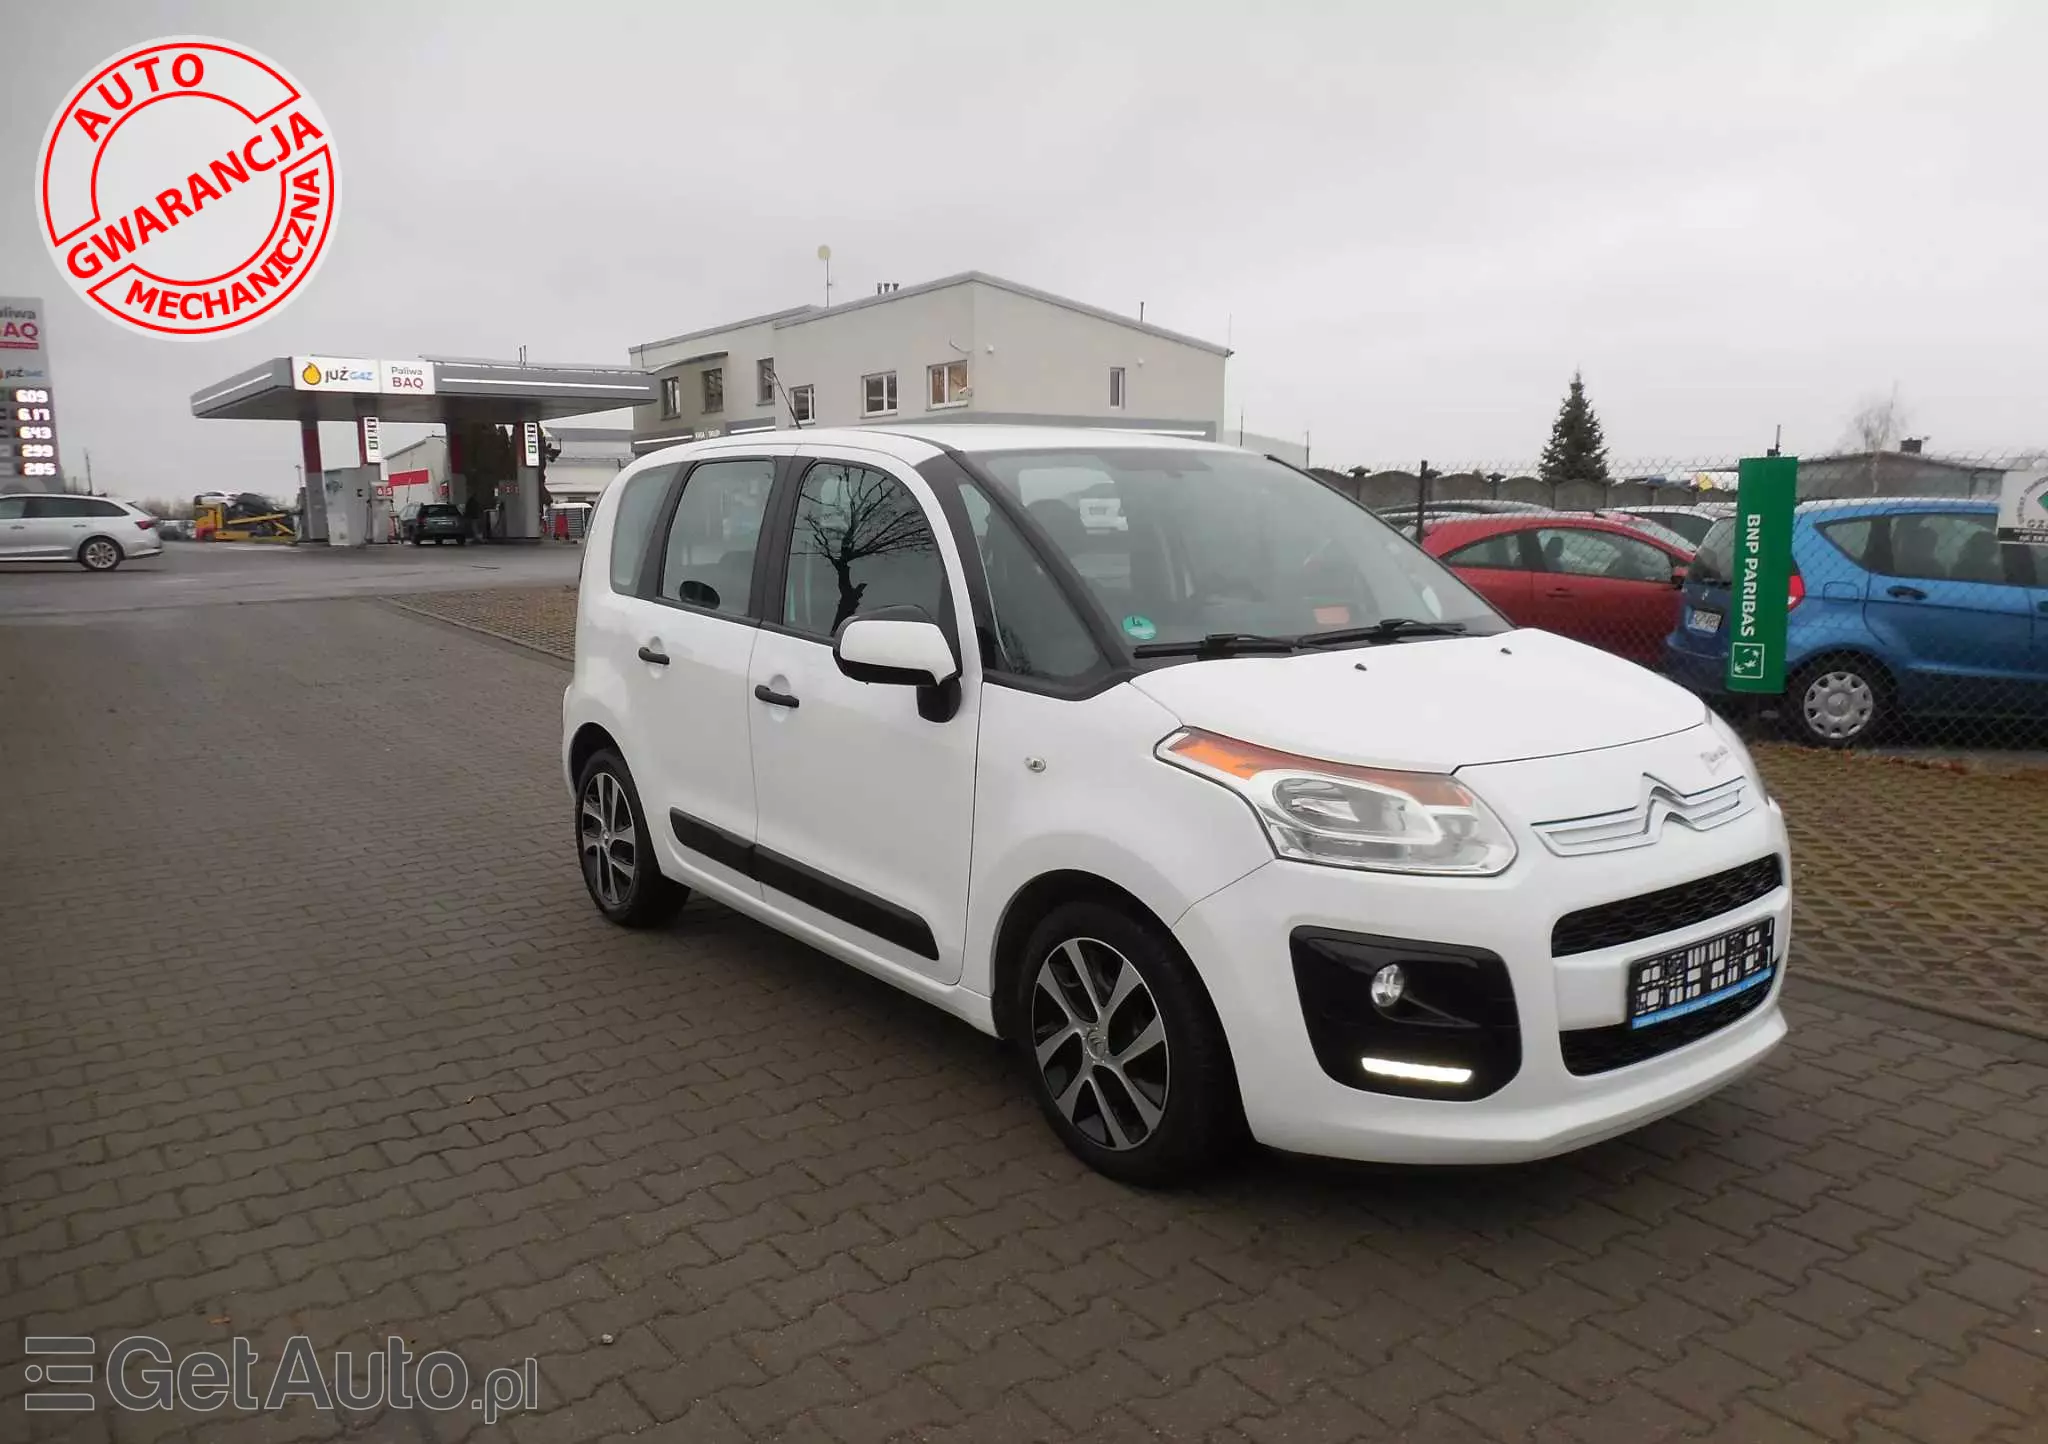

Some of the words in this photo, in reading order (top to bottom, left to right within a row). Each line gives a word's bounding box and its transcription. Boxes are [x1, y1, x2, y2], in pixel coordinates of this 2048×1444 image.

[391, 366, 423, 376] Paliwa
[392, 376, 424, 389] BAQ
[1745, 513, 1761, 553] BNP
[1740, 558, 1760, 637] PARIBAS
